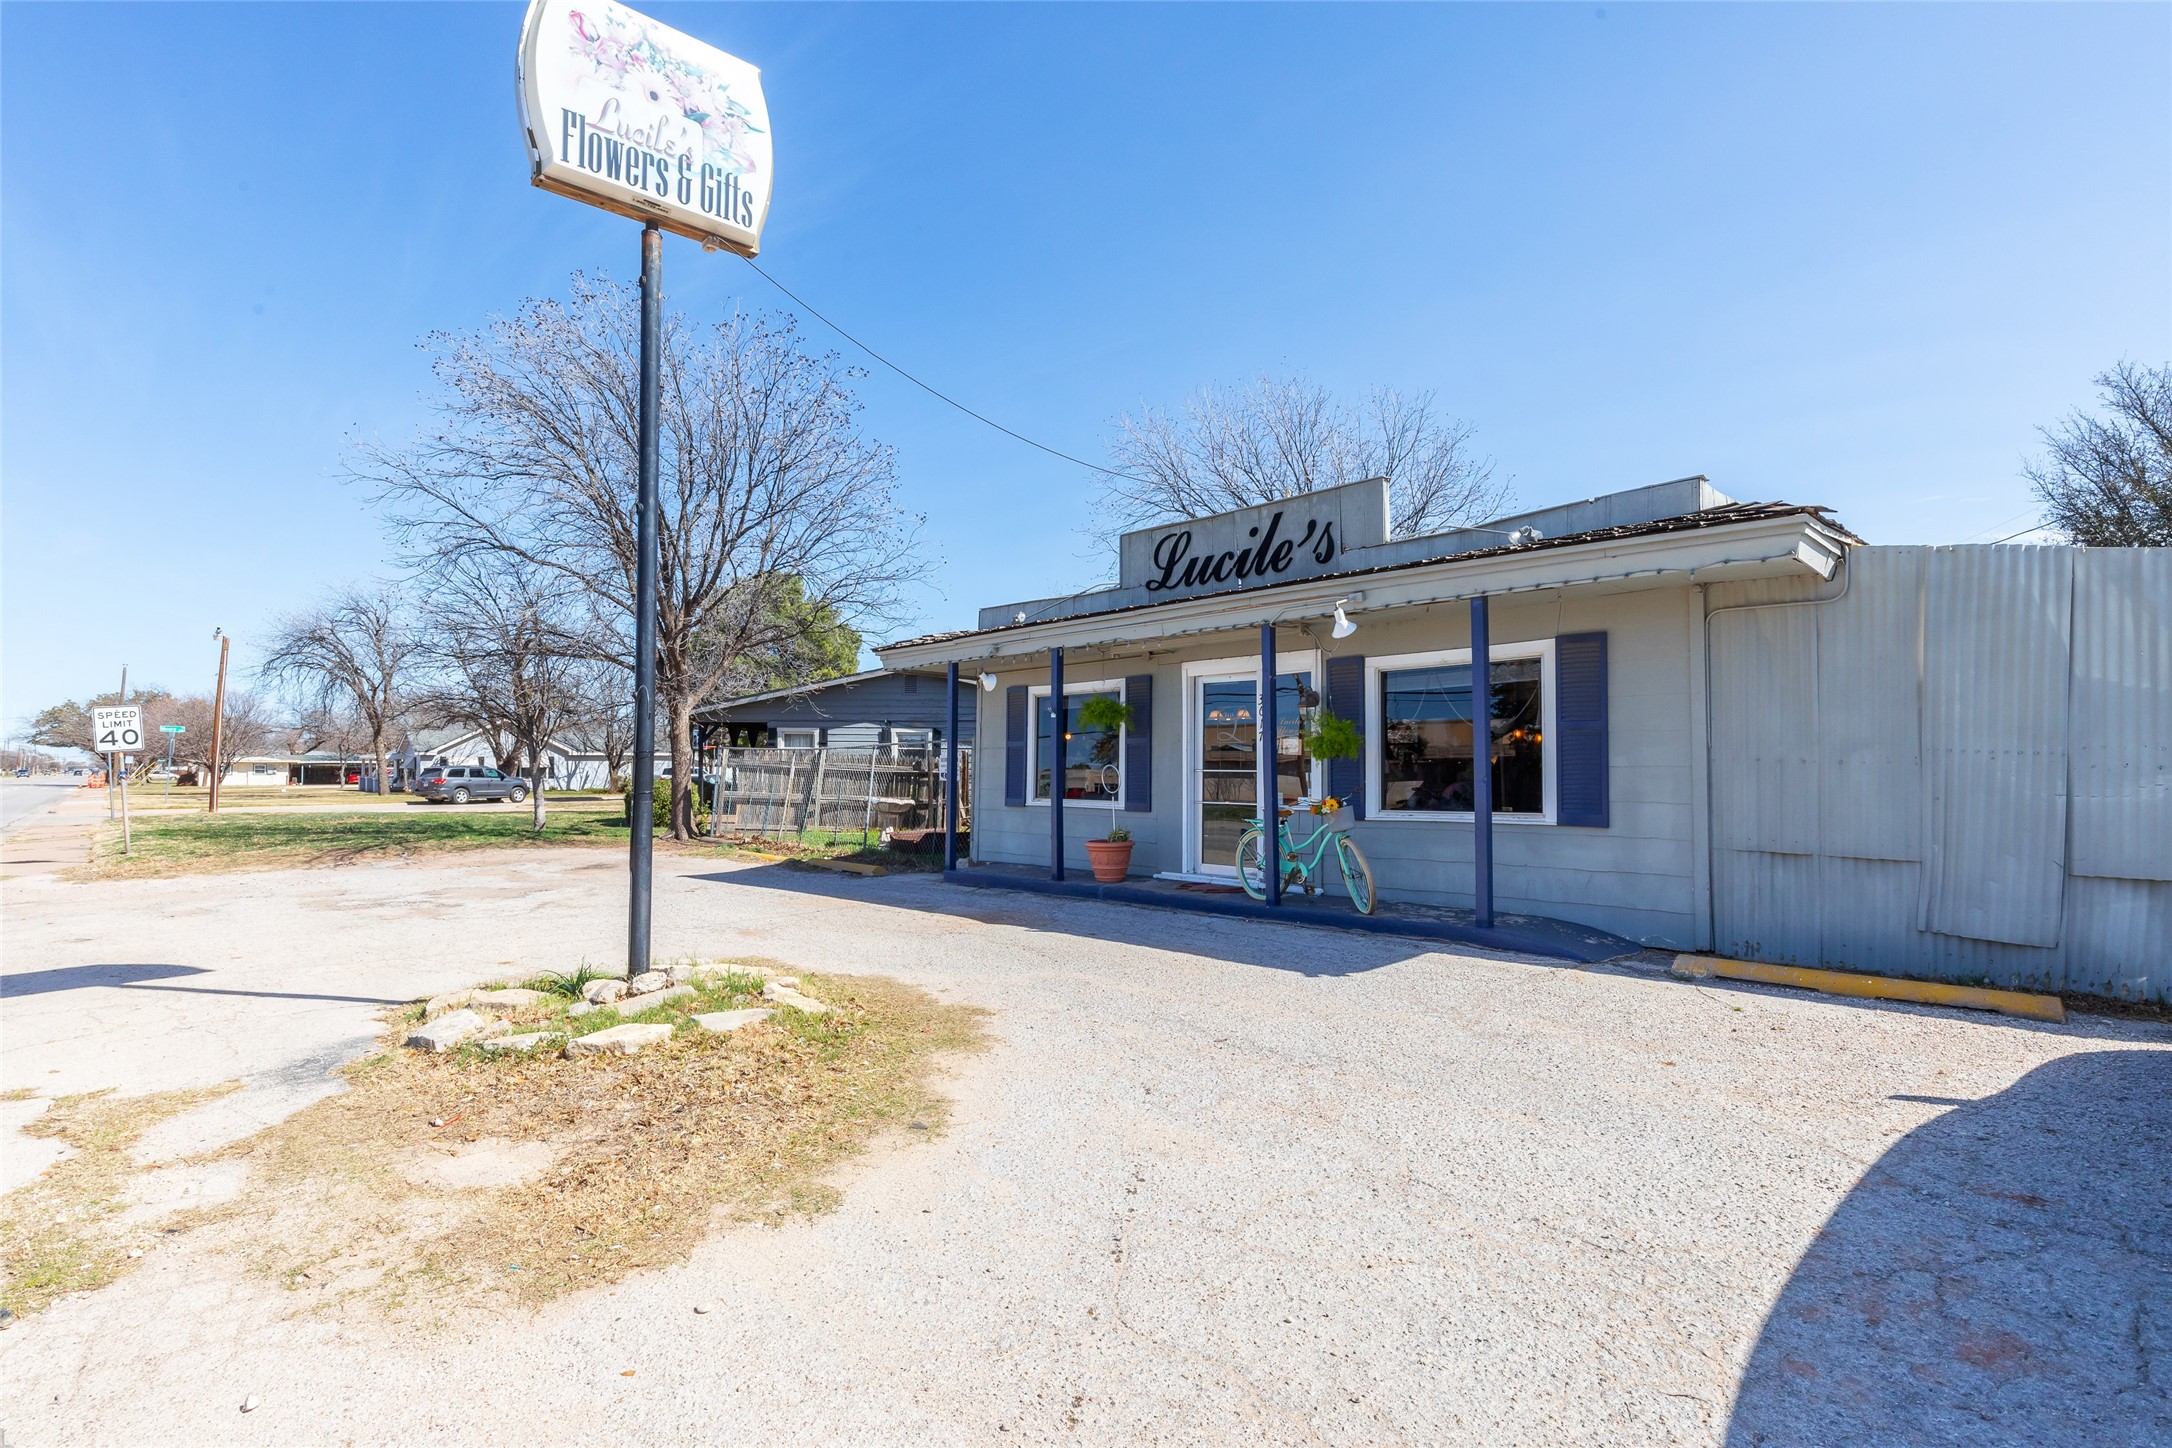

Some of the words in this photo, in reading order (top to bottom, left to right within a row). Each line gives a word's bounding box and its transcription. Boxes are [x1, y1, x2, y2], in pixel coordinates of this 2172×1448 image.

[586, 97, 694, 165] Lucile's
[560, 107, 669, 197] Flowers
[677, 153, 692, 205] &
[700, 163, 753, 228] Gifts
[1145, 511, 1335, 591] Lucile's
[97, 711, 137, 719] SPEED
[102, 720, 133, 728] LIMIT
[99, 729, 139, 745] 40
